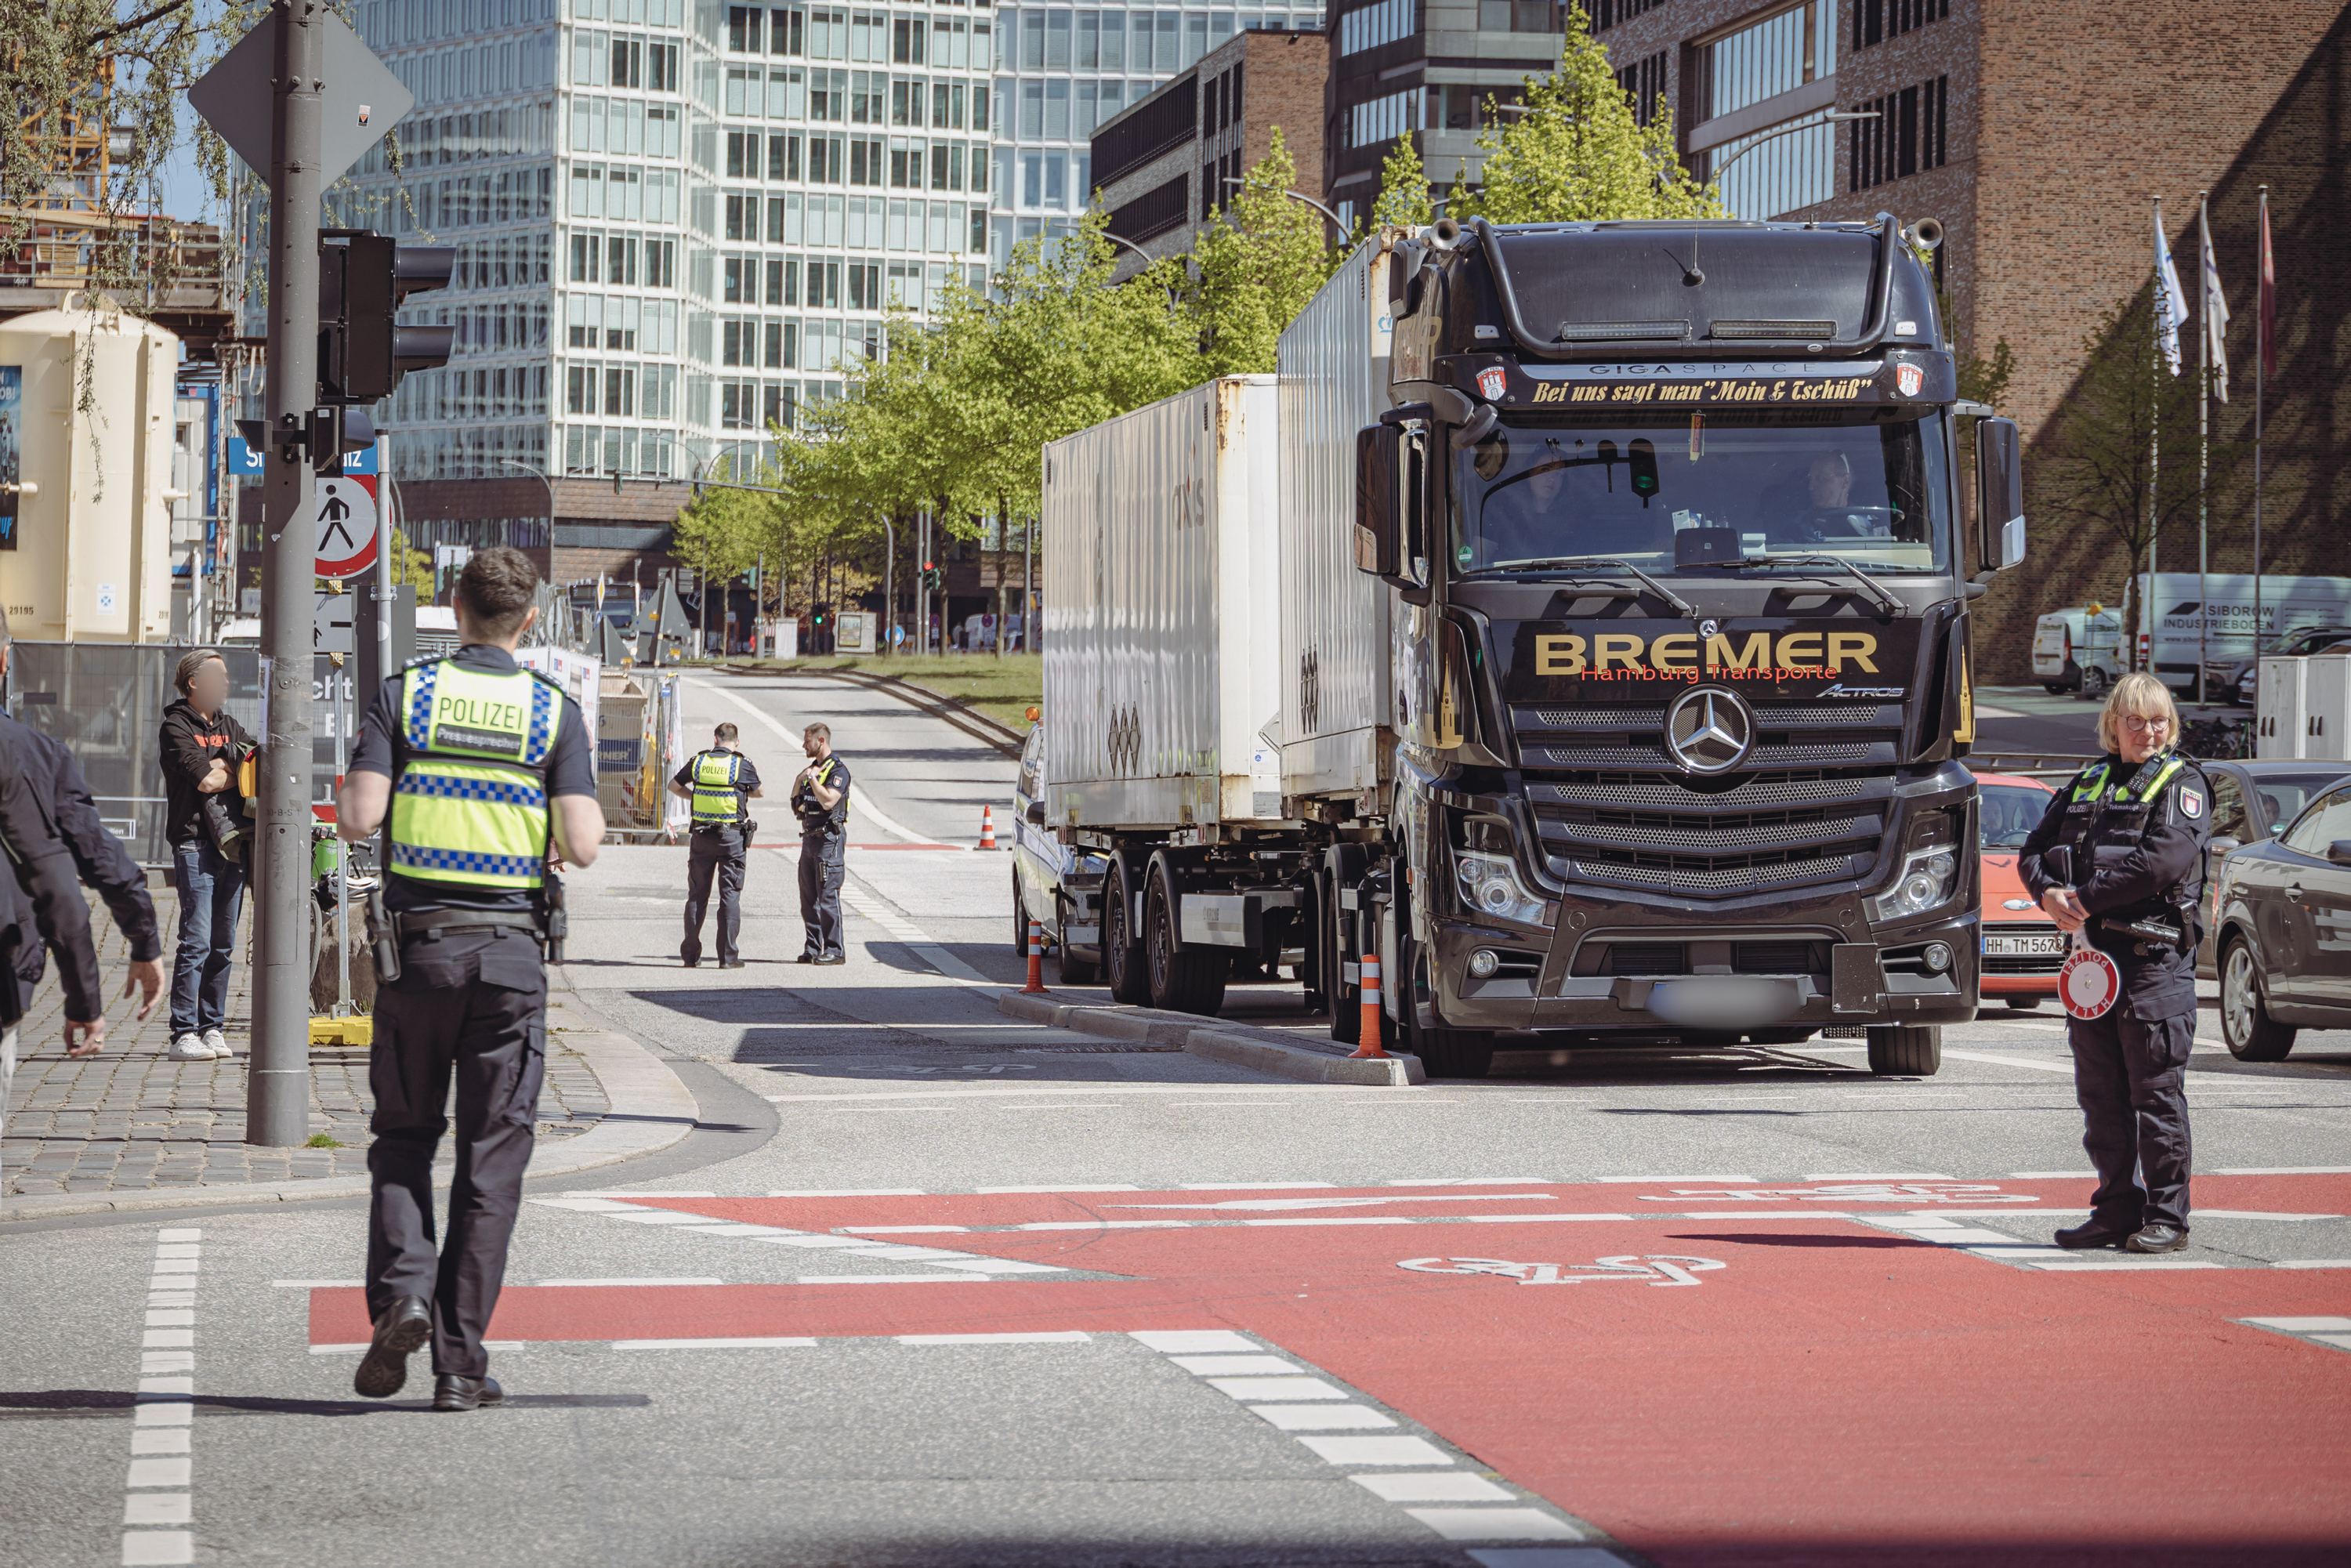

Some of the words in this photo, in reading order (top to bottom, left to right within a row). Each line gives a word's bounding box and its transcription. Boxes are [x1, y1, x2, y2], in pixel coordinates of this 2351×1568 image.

[1532, 382, 1570, 403] Bei
[1570, 386, 1608, 402] uns
[1611, 383, 1656, 404] sagt
[2208, 605, 2275, 617] SIBOROW
[1535, 632, 1880, 675] BREMER
[1581, 664, 1699, 683] Hamburg
[1708, 664, 1838, 683] Transporte
[439, 697, 523, 730] POLIZEI
[437, 726, 521, 750] Pressesprecher
[701, 765, 727, 775] POLIZEI
[2182, 789, 2201, 800] POLIZEI
[2067, 805, 2087, 813] POLIZEI
[1986, 939, 2003, 953] HH
[2012, 938, 2029, 953] TM
[2063, 951, 2110, 976] POLIZEI
[2070, 998, 2110, 1018] HALT
